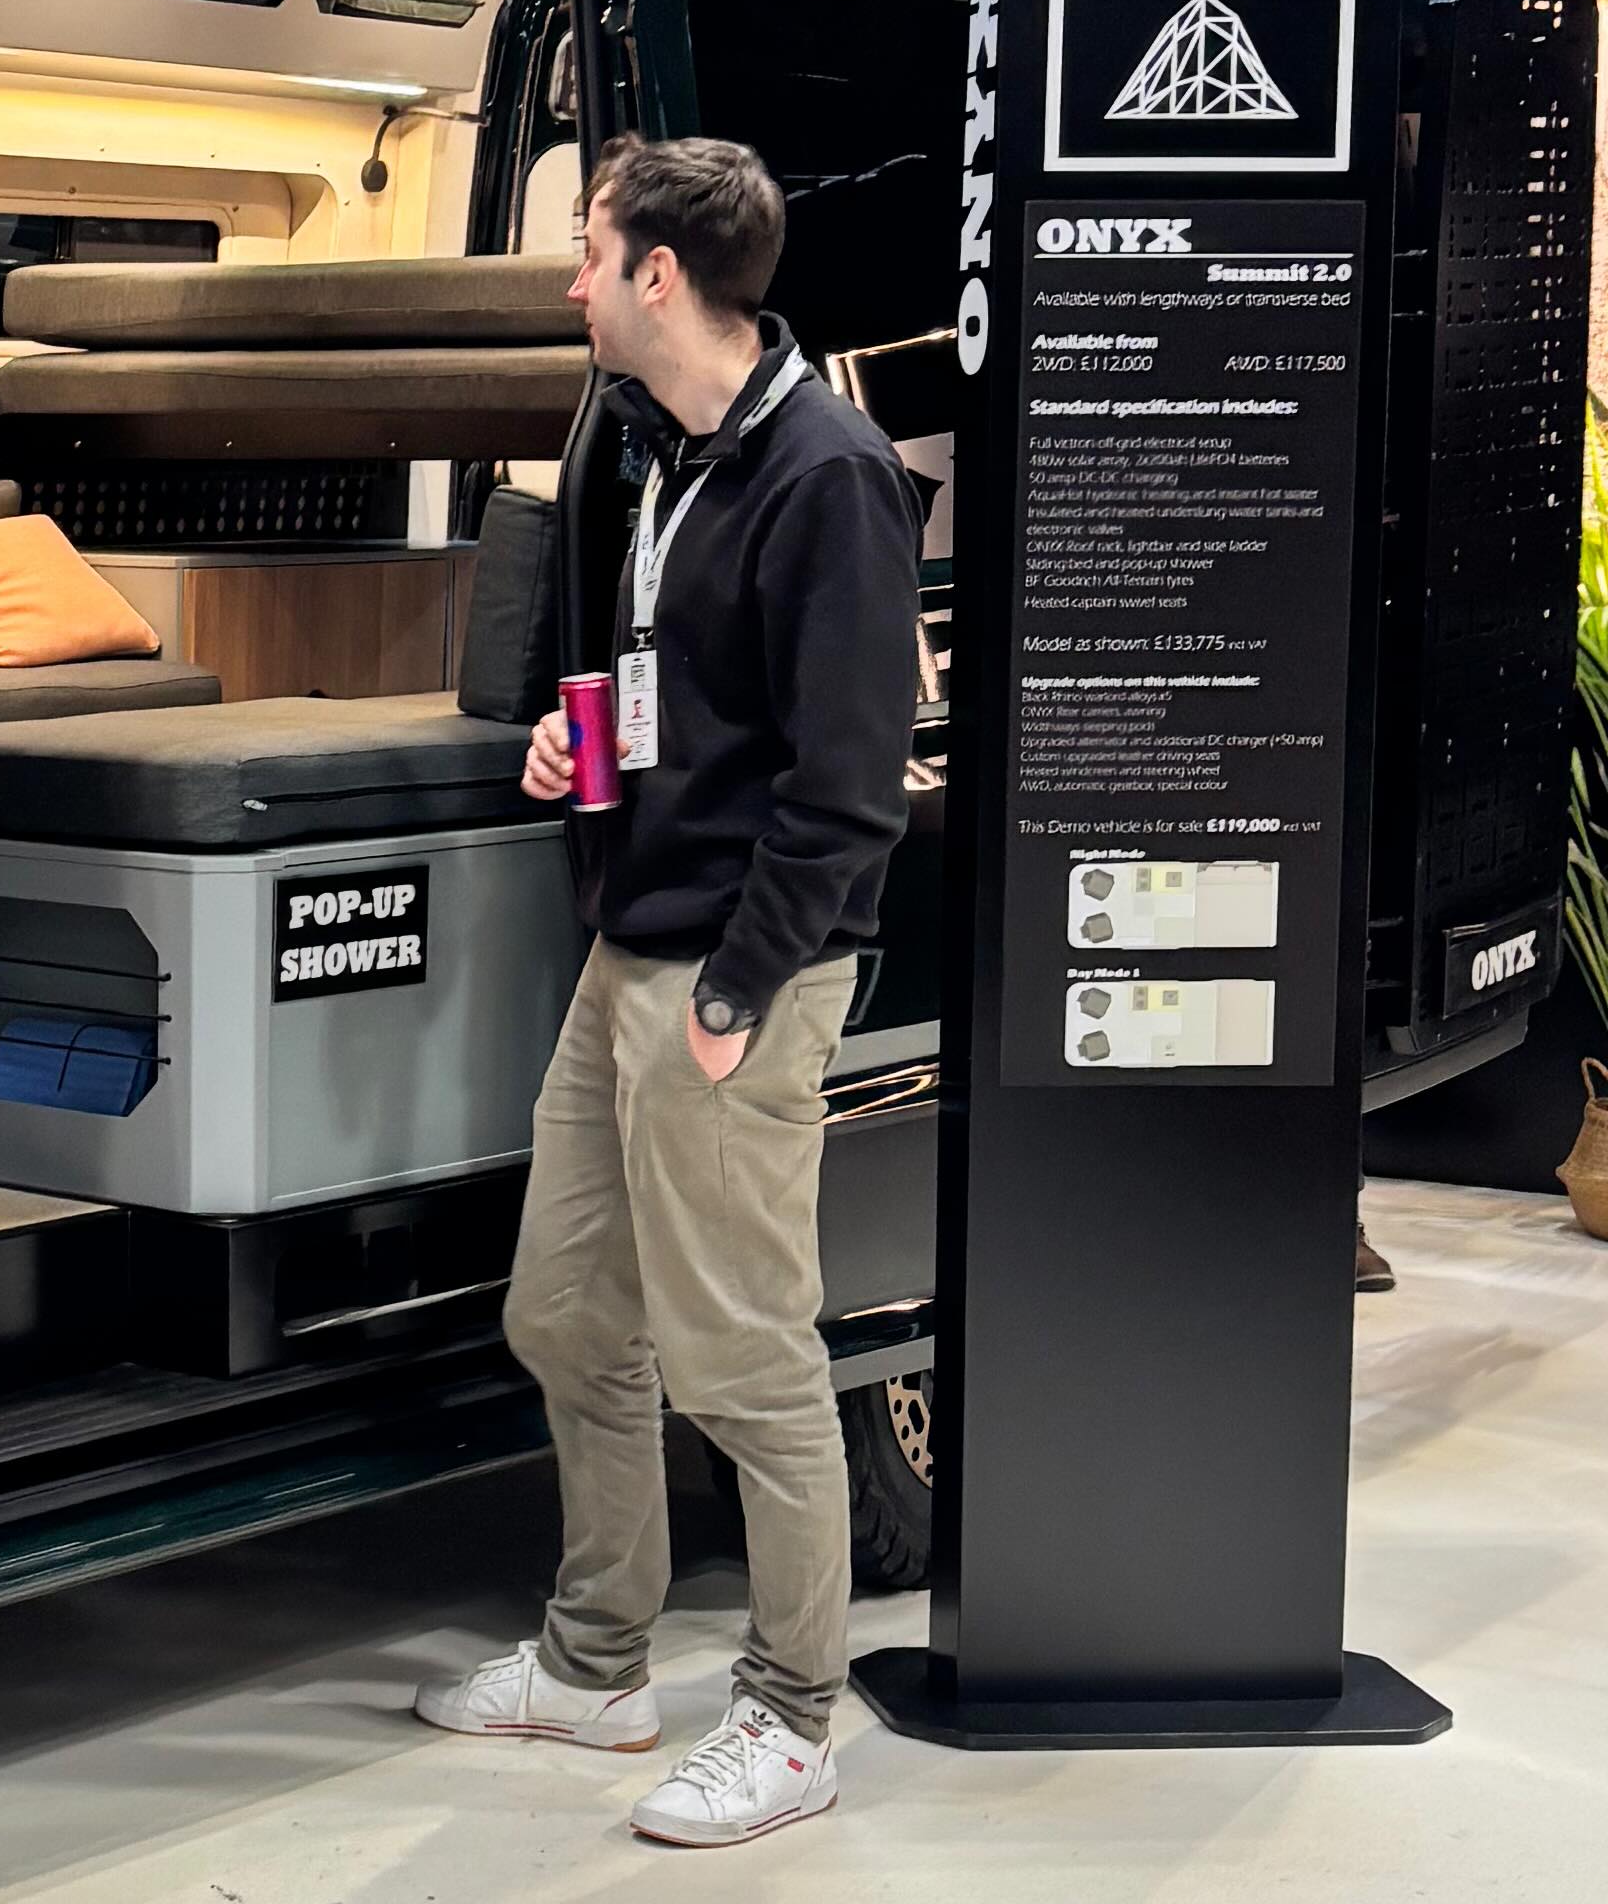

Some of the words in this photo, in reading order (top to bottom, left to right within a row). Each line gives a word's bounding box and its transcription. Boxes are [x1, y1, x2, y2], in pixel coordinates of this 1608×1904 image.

[1037, 218, 1192, 253] ONYX
[1207, 264, 1309, 281] Summit
[1312, 264, 1352, 281] 2.0
[1033, 292, 1100, 306] Available
[1140, 291, 1224, 310] lengthways
[1226, 294, 1243, 305] or
[1320, 293, 1351, 306] bed
[1031, 334, 1114, 349] Available
[1115, 334, 1159, 349] from
[1029, 400, 1110, 414] Standard
[1112, 399, 1220, 418] specification
[1222, 399, 1299, 414] includes:
[1023, 637, 1072, 651] Model
[1074, 639, 1091, 651] as
[1154, 635, 1226, 651] £133,775
[1018, 820, 1045, 833] This
[1047, 820, 1092, 833] Demo
[1093, 820, 1142, 833] vehicle
[1143, 820, 1153, 833] is
[1155, 820, 1175, 832] for
[1178, 820, 1203, 832] sale
[1206, 819, 1281, 833] £119,000
[289, 884, 416, 929] POP-UP
[280, 934, 422, 983] SHOWER
[1472, 930, 1536, 990] ONYX
